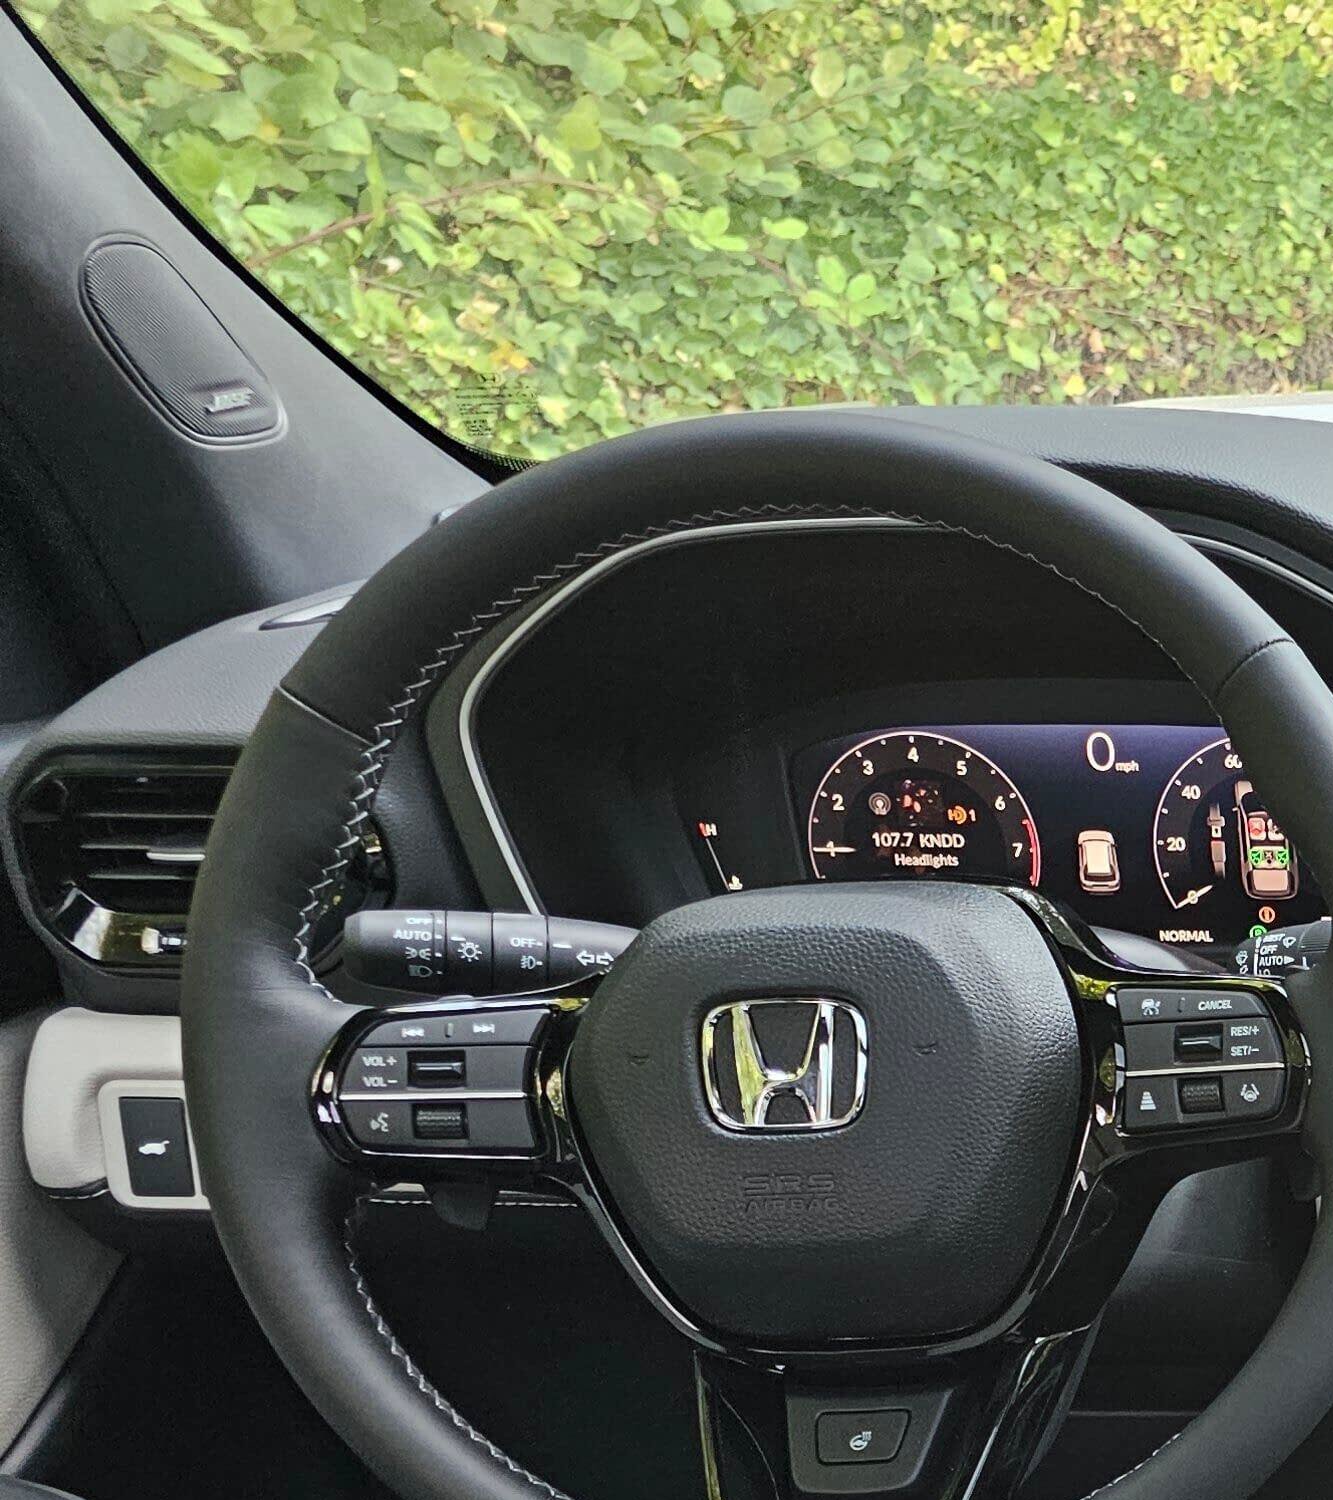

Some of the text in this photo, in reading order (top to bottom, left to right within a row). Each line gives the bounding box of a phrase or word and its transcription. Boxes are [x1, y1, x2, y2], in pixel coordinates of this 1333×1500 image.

[907, 747, 919, 762] 4
[1086, 732, 1115, 771] 0
[862, 760, 874, 775] 3
[956, 760, 967, 776] 5
[1115, 760, 1139, 773] mph
[1181, 785, 1200, 799] 40
[832, 794, 845, 811] 2
[995, 795, 1006, 810] 6
[872, 832, 966, 849] 107.7 KNDD
[1167, 837, 1186, 852] 20
[1012, 843, 1023, 858] 7
[894, 853, 959, 868] Headlights
[393, 929, 432, 941] AUTO
[510, 937, 536, 948] OFF
[1159, 930, 1214, 943] NORMAL
[1260, 945, 1278, 956] OFF
[1259, 956, 1284, 967] AUTO
[1198, 999, 1233, 1011] CANCEL
